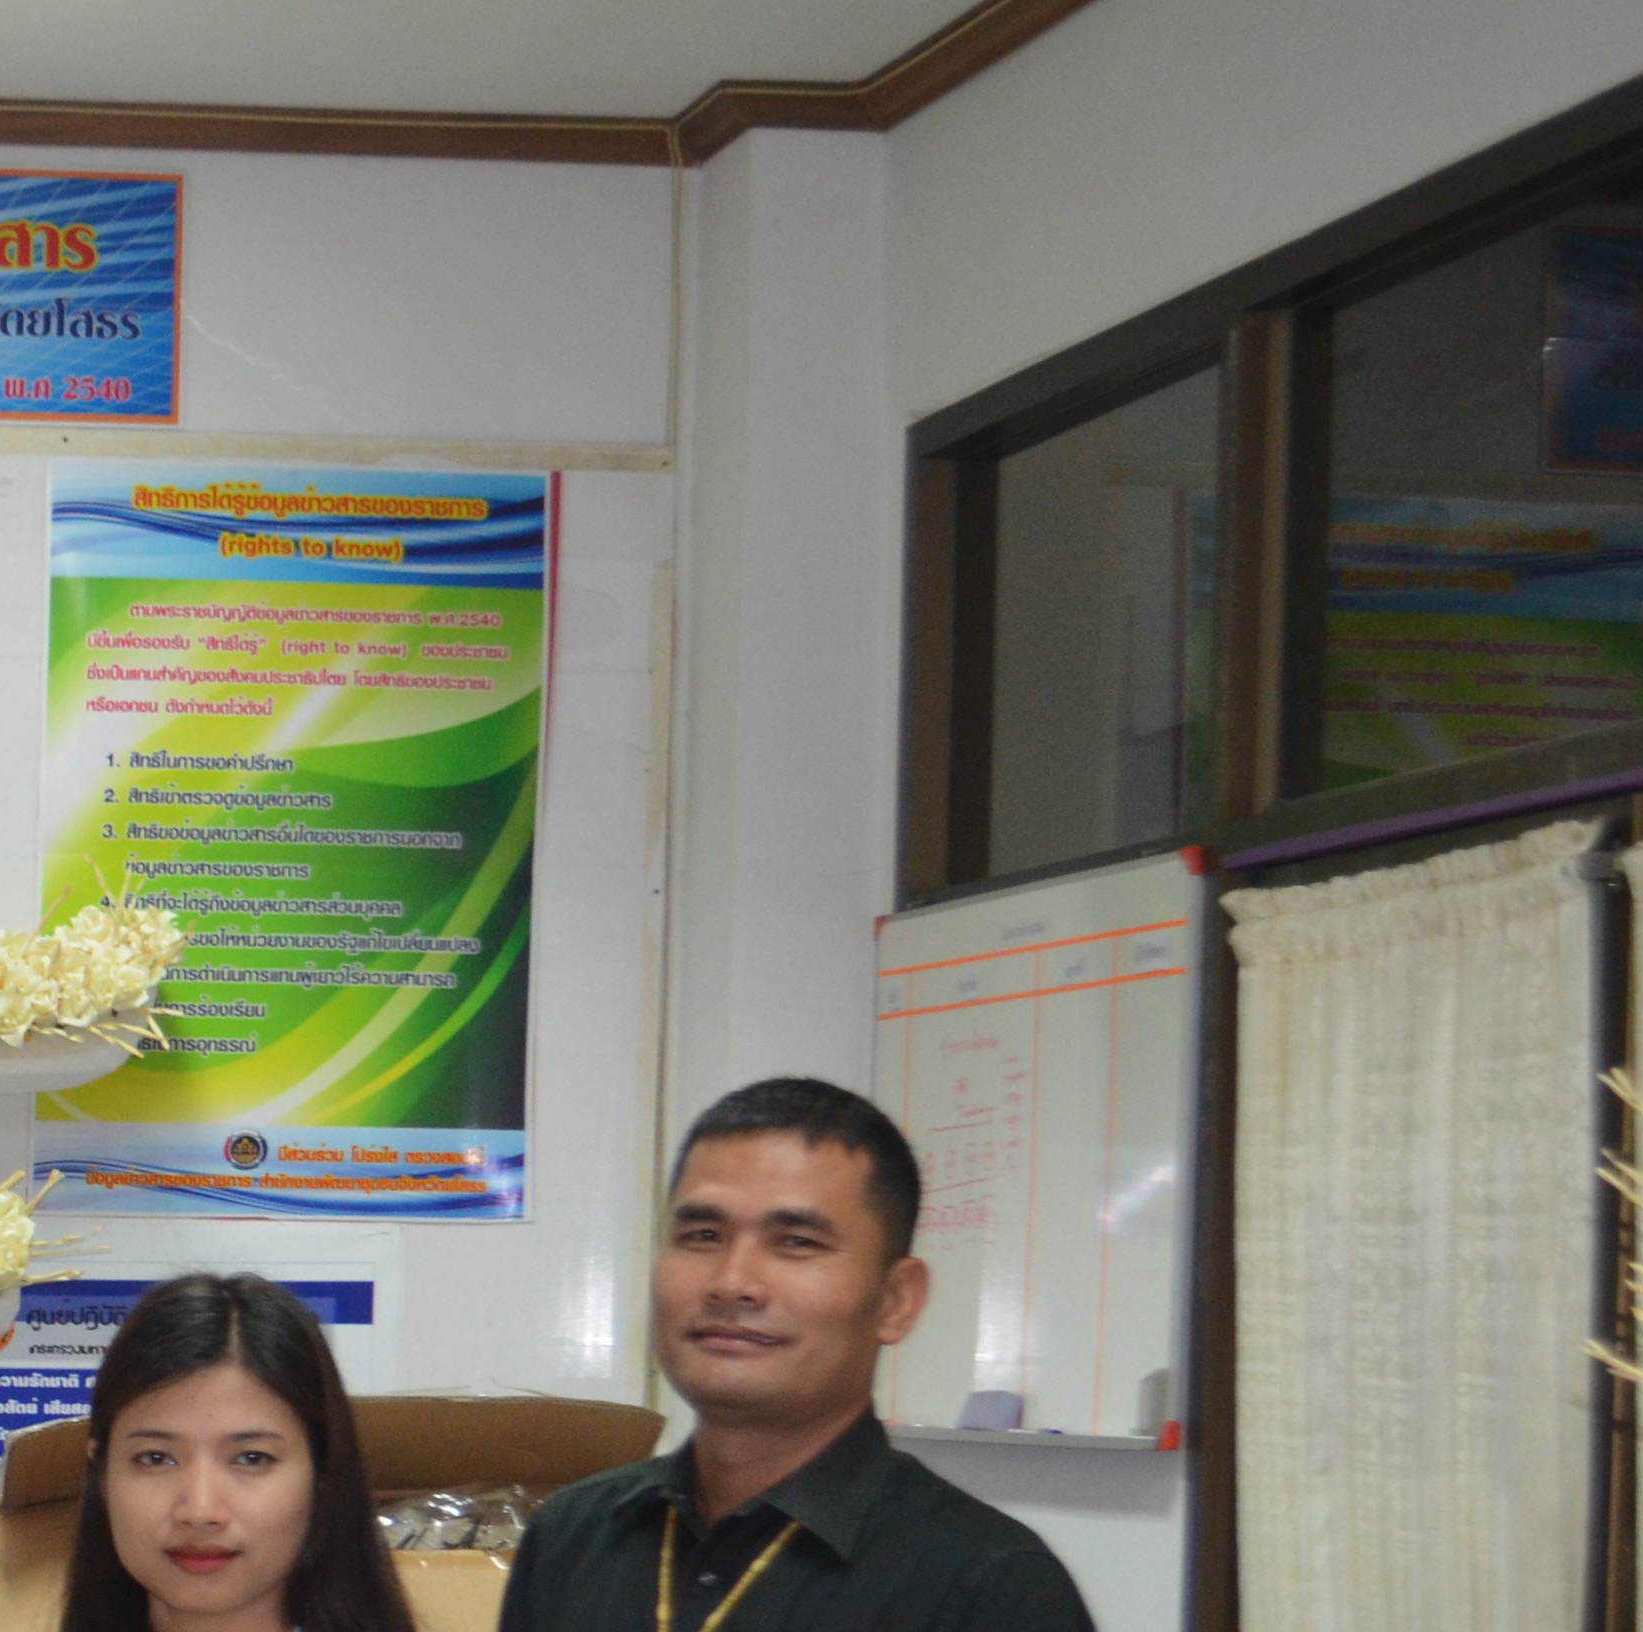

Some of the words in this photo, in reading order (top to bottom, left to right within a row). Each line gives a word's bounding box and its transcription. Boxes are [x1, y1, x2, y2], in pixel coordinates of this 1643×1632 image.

[63, 375, 131, 402] 2540
[133, 481, 489, 519] สิทธิการได้รู้ข้อมูลข่าวสารของราชการ
[219, 532, 294, 558] (rights
[301, 535, 327, 556] to
[332, 536, 403, 563] know)
[281, 638, 326, 656] (right
[334, 642, 351, 655] to
[357, 642, 407, 658] know)
[107, 754, 121, 768] 1.
[129, 750, 295, 773] สิทธิในการขอคำปรึกษา
[104, 788, 119, 803] 2.
[102, 824, 118, 839] 3.
